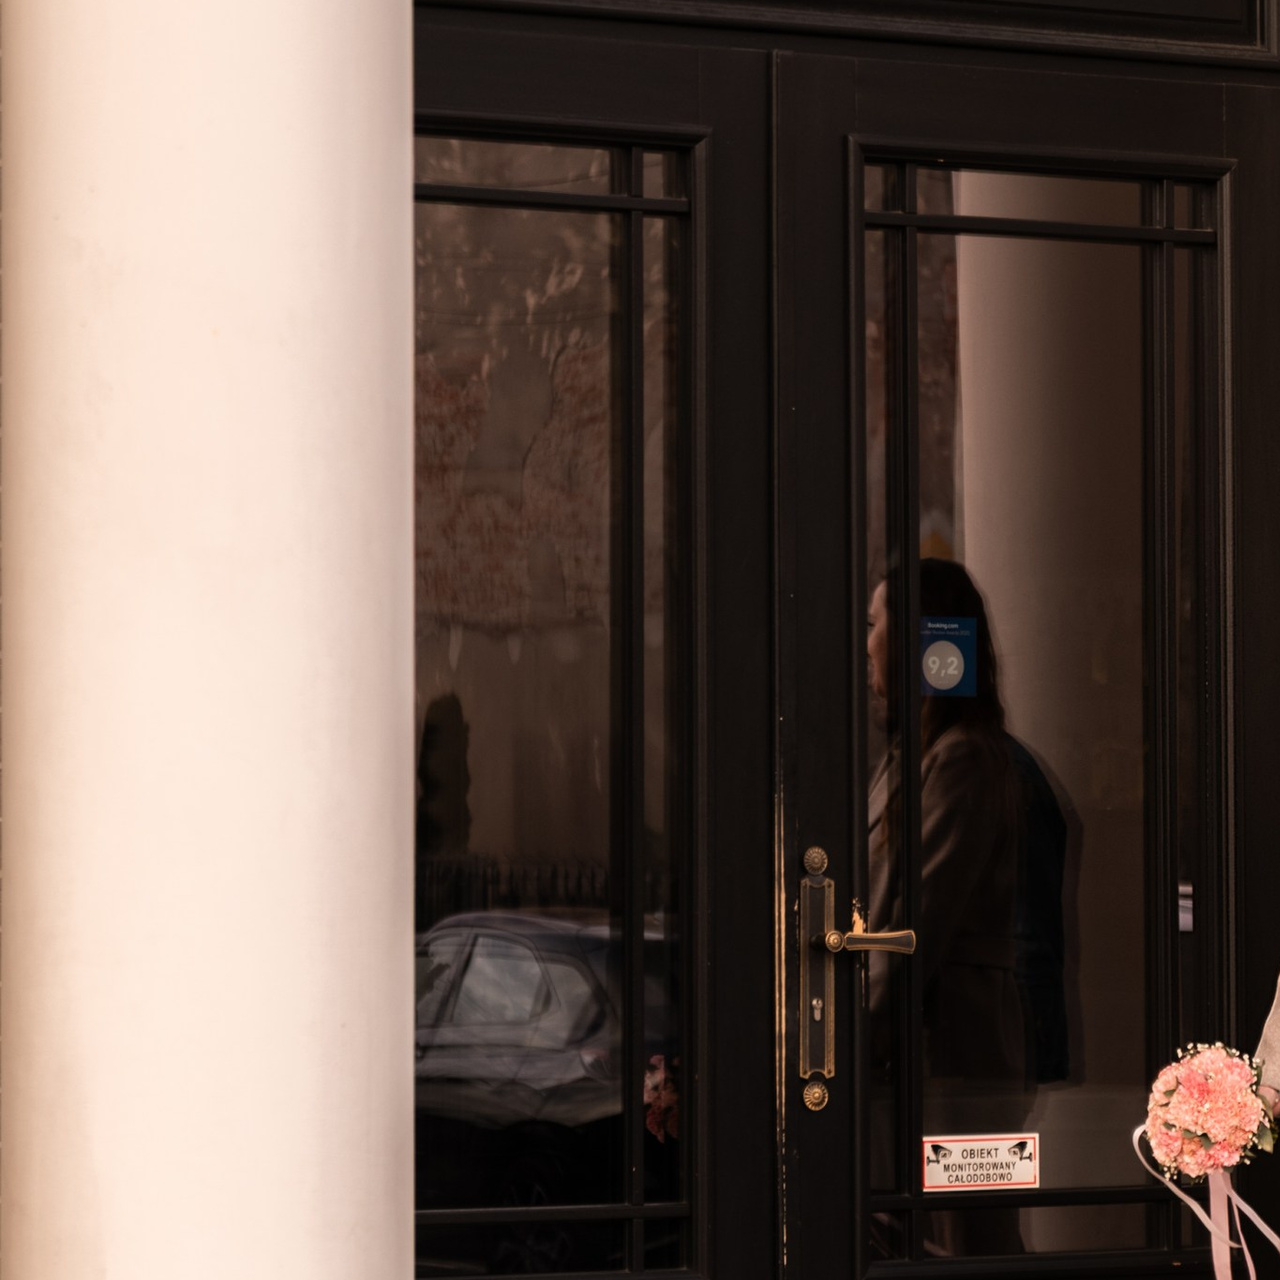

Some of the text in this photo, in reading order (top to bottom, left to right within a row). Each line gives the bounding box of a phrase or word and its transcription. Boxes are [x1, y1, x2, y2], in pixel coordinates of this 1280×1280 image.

[927, 622, 959, 630] Booking.com
[928, 656, 958, 677] 9,2
[961, 1148, 1000, 1159] OBIEKT
[943, 1161, 1017, 1173] MONITOROWANY
[947, 1172, 1013, 1184] CAŁODOBOWO
